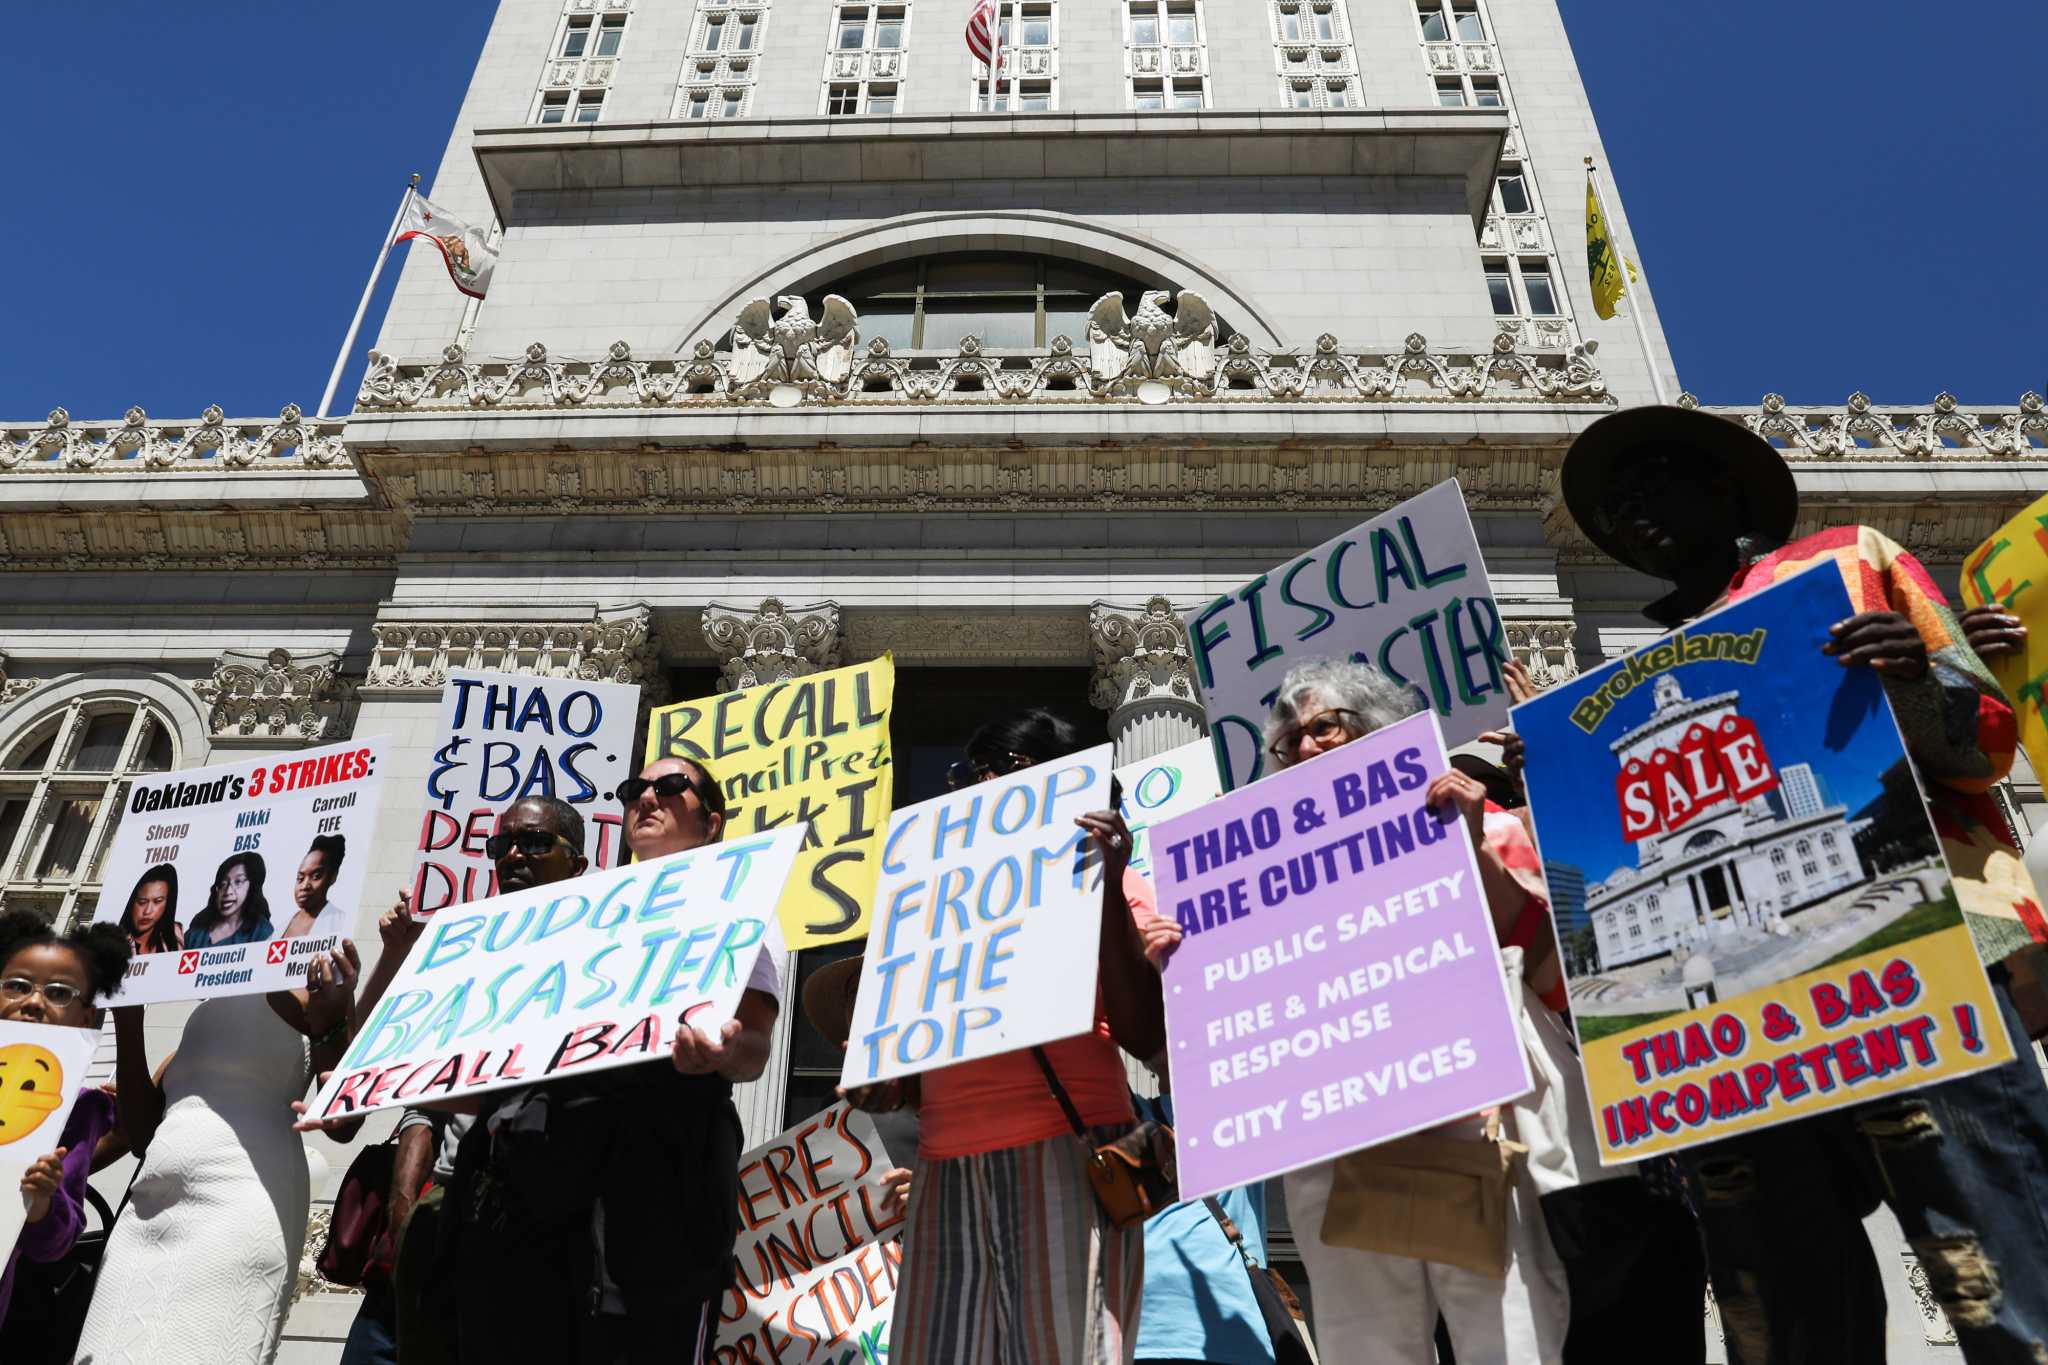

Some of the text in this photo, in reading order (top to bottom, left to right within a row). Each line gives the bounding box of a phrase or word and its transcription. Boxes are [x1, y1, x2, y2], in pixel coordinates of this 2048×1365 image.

[1189, 515, 1467, 688] FISCAL
[452, 679, 602, 737] THAO
[657, 671, 888, 760] RECALL
[1211, 597, 1507, 792] DSTER
[1570, 628, 1767, 734] Brokeland
[131, 748, 376, 813] Oakland's 3 STRIKES:
[235, 809, 271, 828] Nikki
[312, 792, 356, 813] Carroll
[428, 736, 616, 810] & BAS:
[882, 764, 1096, 875] CHOP
[1166, 805, 1281, 883] THAO
[1293, 797, 1327, 834] &
[1332, 747, 1428, 820] BAS
[1624, 734, 1771, 832] SALE
[144, 845, 178, 864] THAO
[146, 823, 190, 842] Sheng
[234, 833, 260, 851] BAS
[317, 816, 341, 833] FIFE
[1176, 804, 1448, 939] ARE CUTTING
[415, 837, 775, 974] BUDGET
[880, 828, 1094, 959] FROM
[1204, 870, 1465, 992] PUBLIC SAFETY
[124, 962, 149, 979] yor
[194, 969, 252, 988] President
[200, 948, 246, 967] Council
[290, 936, 337, 955] Council
[345, 919, 766, 1069] BASASTER
[874, 918, 1024, 1027] THE
[1206, 932, 1475, 1047] FIRE & MEDICAL
[863, 1006, 1002, 1079] TOP
[1208, 1001, 1393, 1088] RESPONSE
[1622, 958, 1921, 1083] THAO & BAS
[322, 1042, 526, 1117] RECALL
[1212, 1037, 1478, 1149] CITY SERVICES
[1602, 1015, 1937, 1148] INCOMPETENT
[736, 1103, 873, 1236] ERE'S
[719, 1184, 905, 1323] OUNCIL
